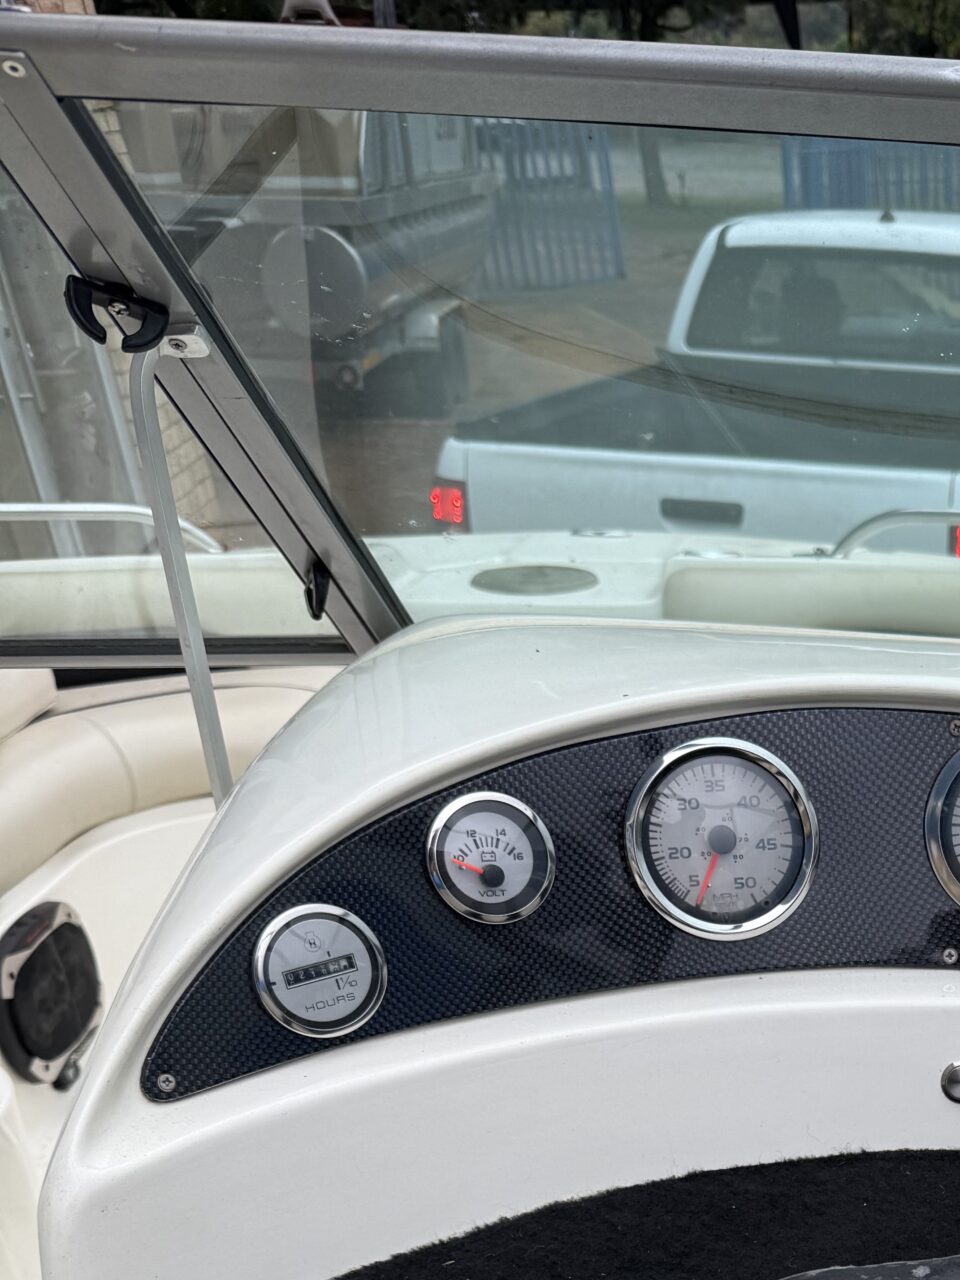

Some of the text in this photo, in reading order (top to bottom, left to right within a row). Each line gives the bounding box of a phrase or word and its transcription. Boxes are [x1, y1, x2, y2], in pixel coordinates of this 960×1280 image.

[704, 779, 725, 792] 35
[677, 797, 700, 811] 30
[737, 795, 760, 808] 40
[466, 829, 477, 838] 12
[495, 828, 507, 836] 14
[756, 838, 778, 850] 45
[513, 852, 524, 861] 16
[668, 846, 691, 860] 20
[689, 874, 700, 887] 5
[734, 877, 756, 889] 50
[478, 889, 507, 898] VOLT
[305, 992, 356, 1013] HOURS
